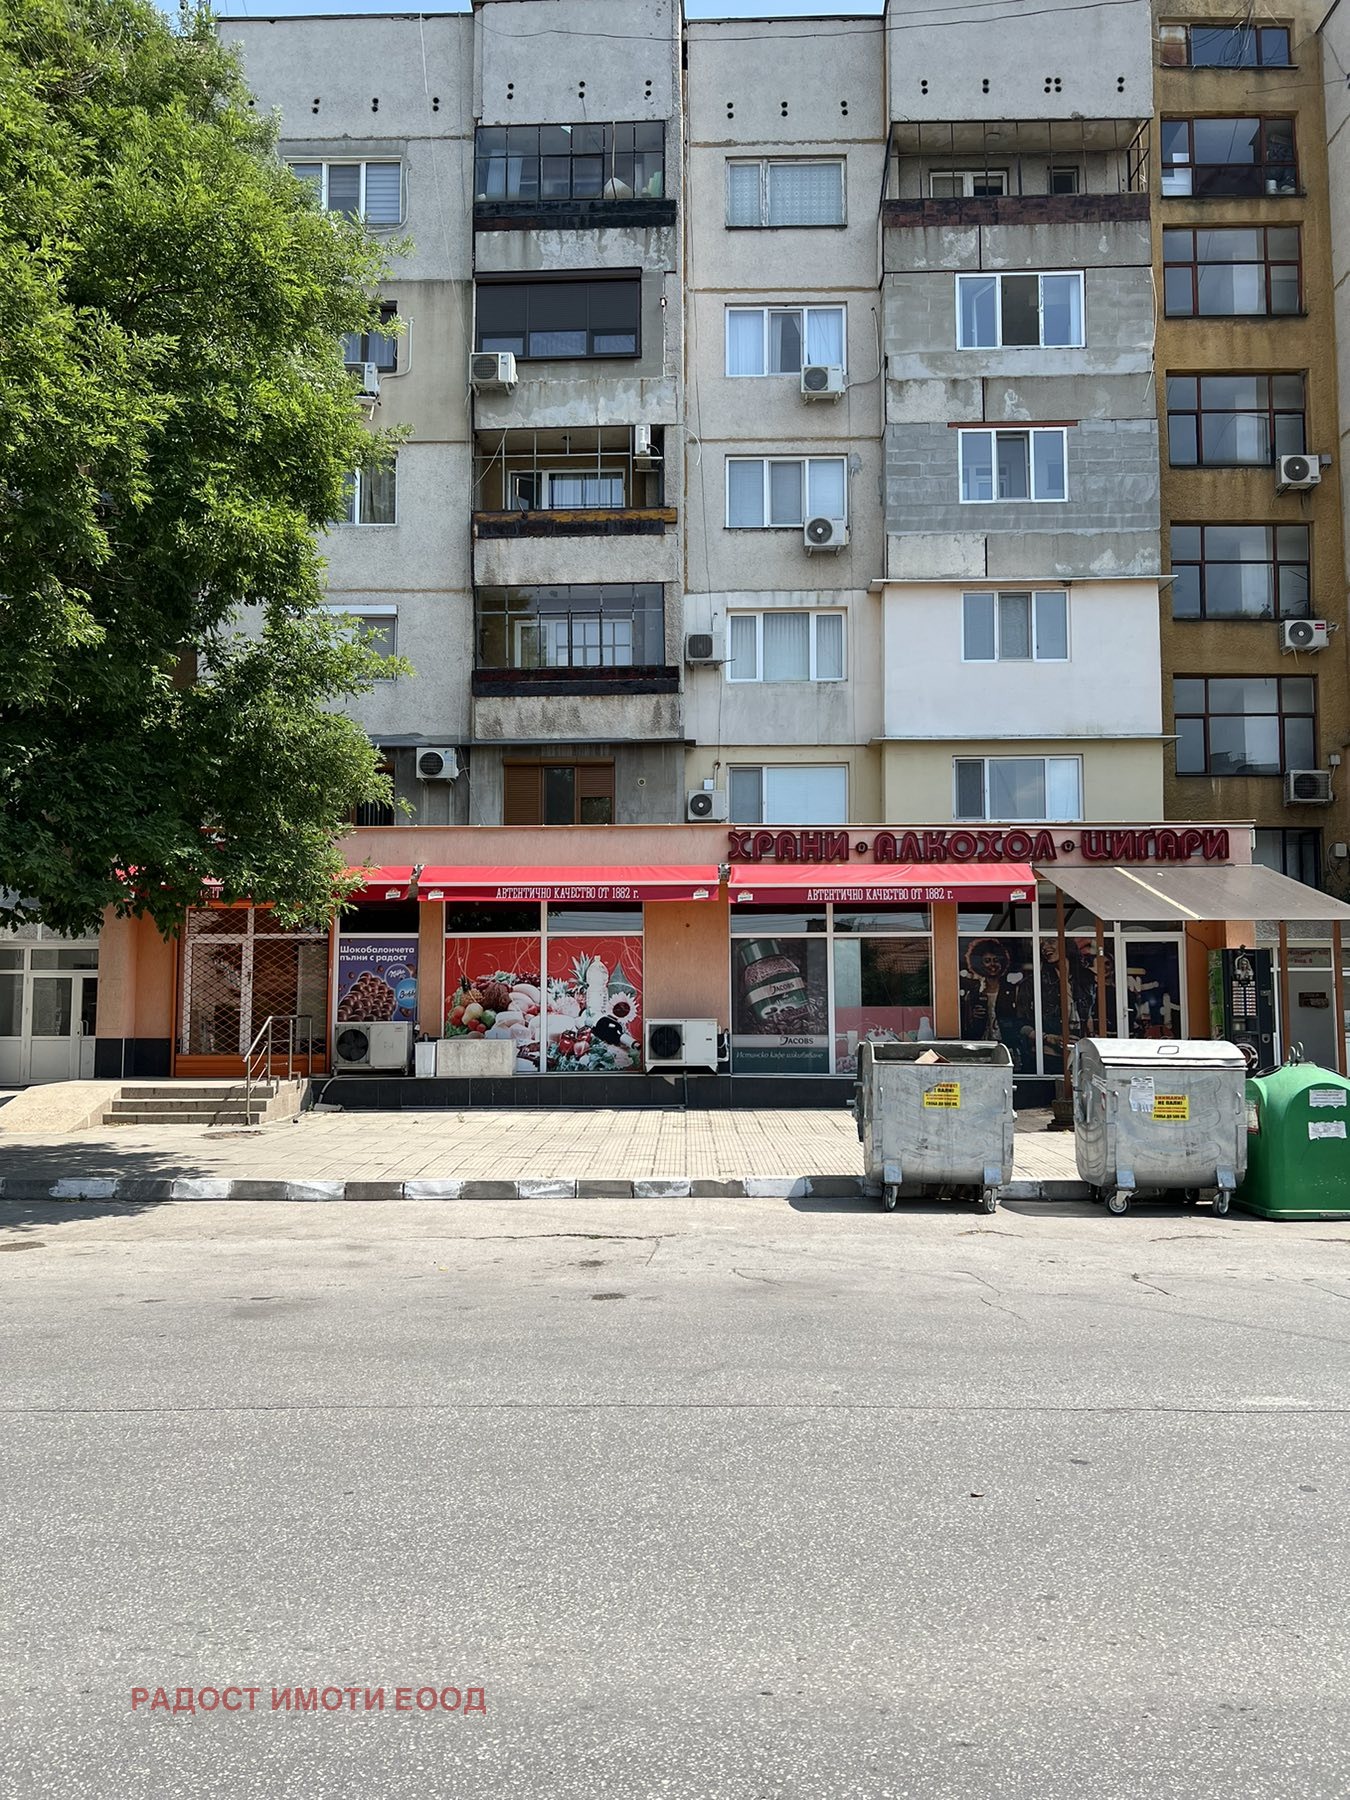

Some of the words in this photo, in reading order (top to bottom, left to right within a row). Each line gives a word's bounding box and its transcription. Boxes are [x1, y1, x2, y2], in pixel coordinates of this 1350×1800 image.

[728, 831, 850, 862] ХРАНИ
[873, 830, 1057, 862] АЛКОХОЛ
[1081, 829, 1230, 861] ЦИГАРИ
[496, 887, 552, 899] АВТЕНТИЧНО
[554, 887, 596, 899] КАЧЕСТВО
[598, 887, 609, 899] ОТ
[612, 887, 631, 899] 1882
[807, 888, 863, 901] АВТЕНТИЧНО
[866, 888, 909, 901] КАЧЕСТВО
[911, 888, 922, 900] ОТ
[925, 887, 945, 900] 1882
[340, 945, 415, 954] Шокобалончета
[376, 955, 407, 963] радост
